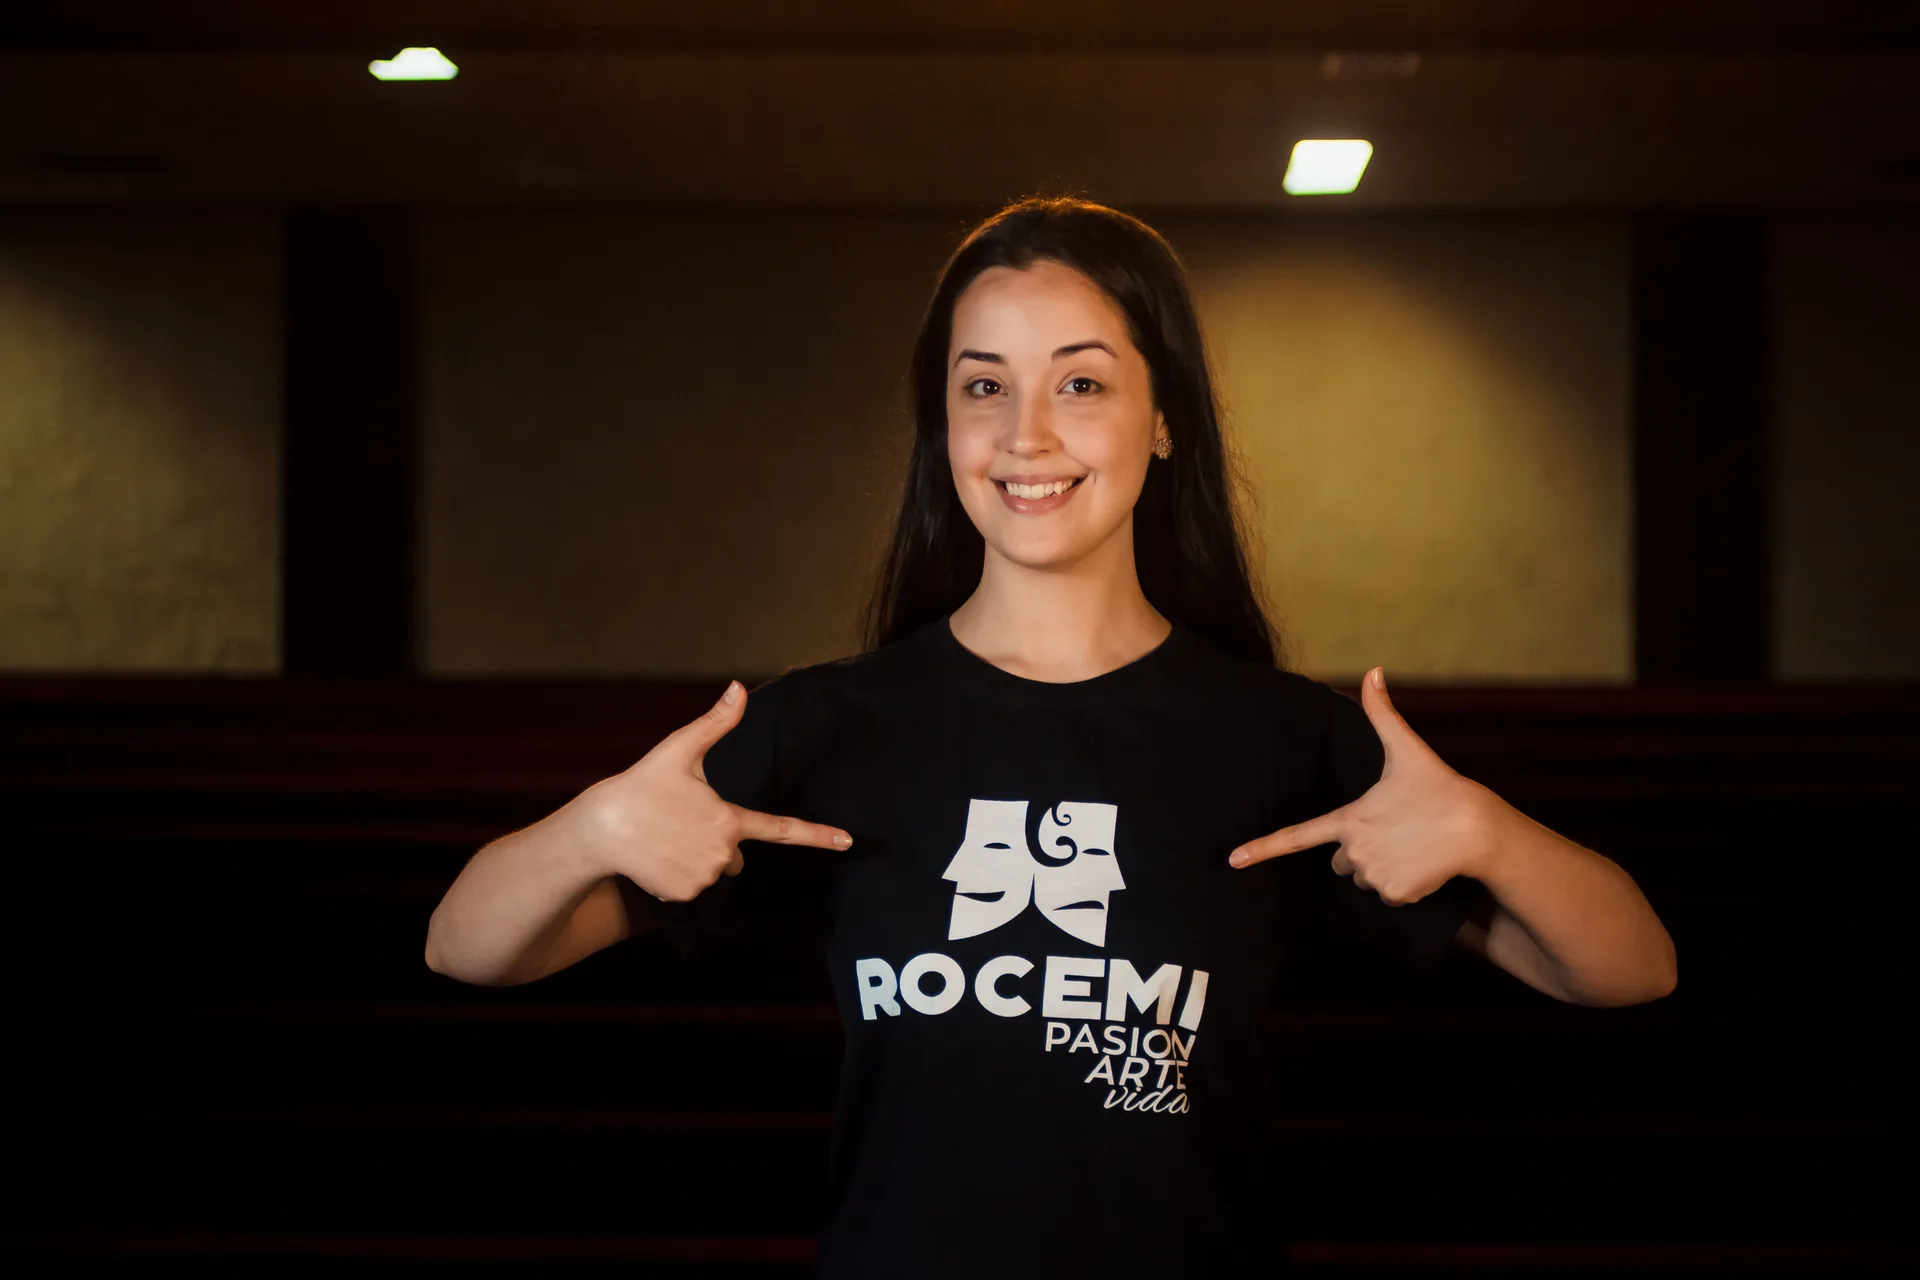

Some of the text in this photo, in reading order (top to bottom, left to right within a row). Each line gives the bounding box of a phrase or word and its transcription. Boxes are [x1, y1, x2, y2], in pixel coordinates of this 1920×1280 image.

[855, 952, 1210, 1032] ROCEMI
[1044, 1021, 1197, 1061] PASION
[1084, 1054, 1190, 1090] ARTE
[1103, 1084, 1191, 1114] vida
